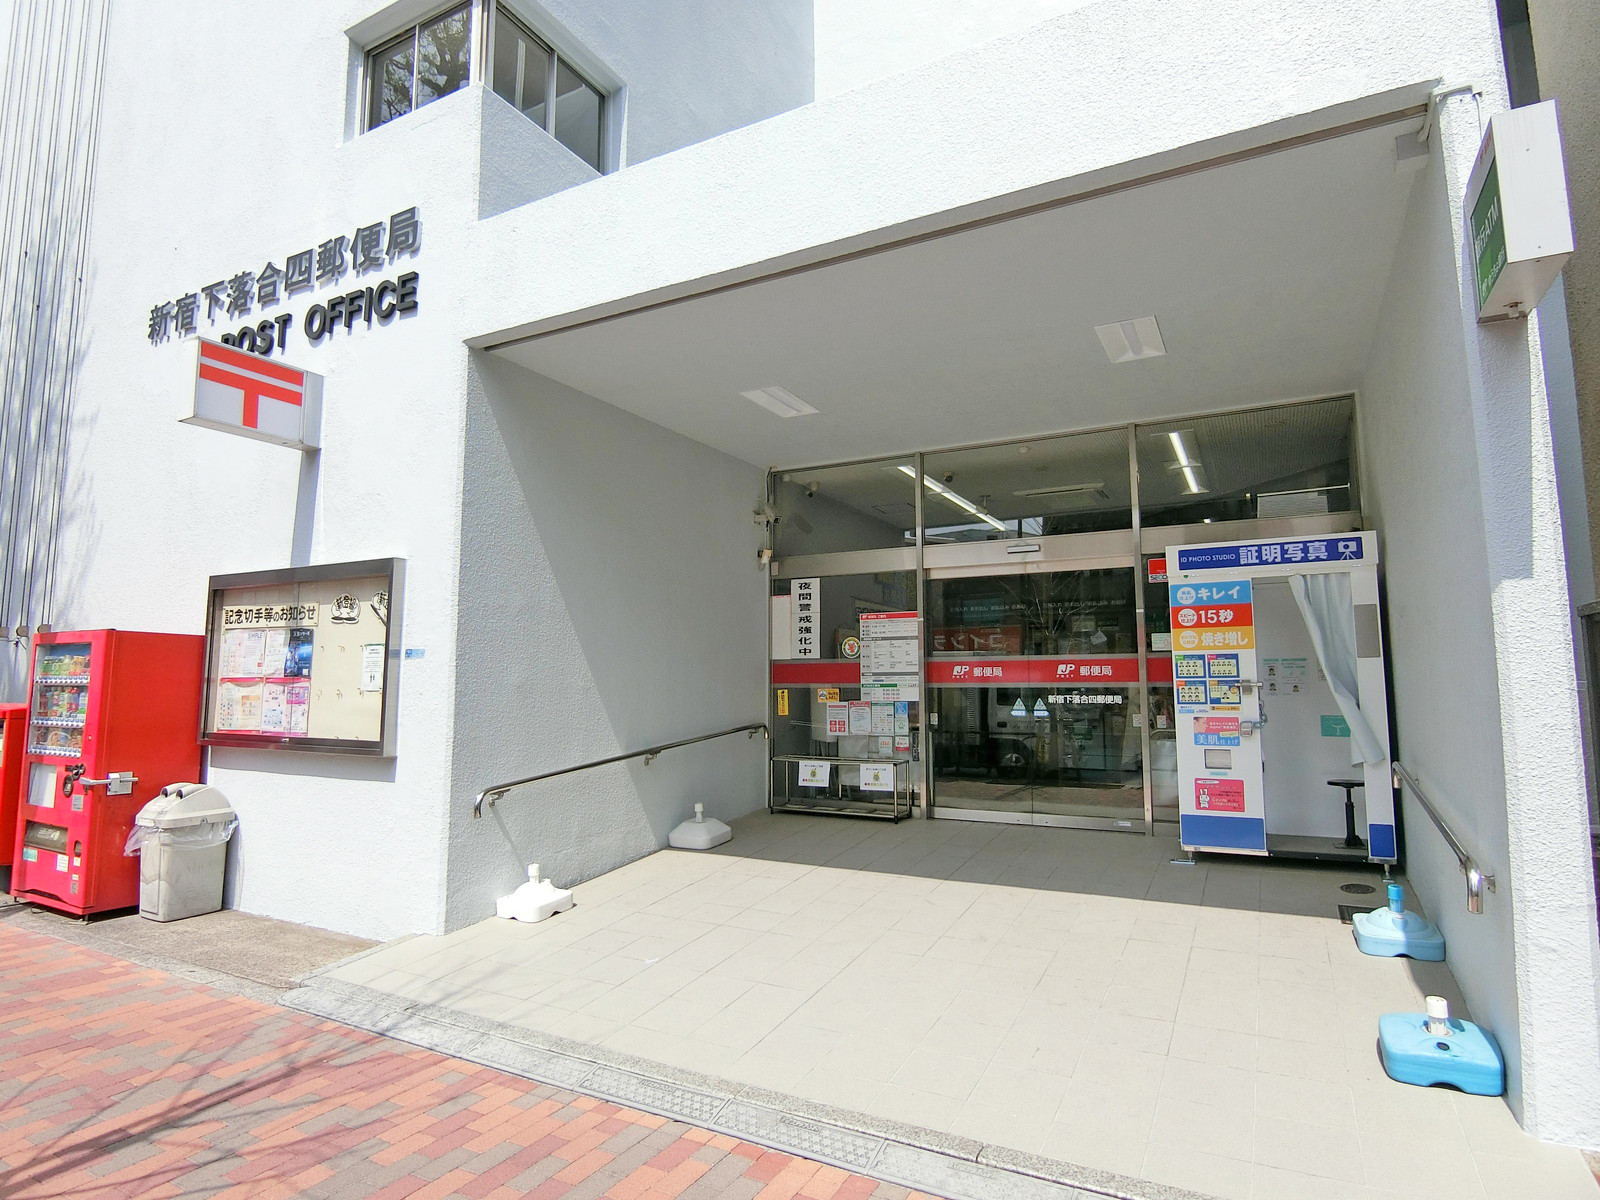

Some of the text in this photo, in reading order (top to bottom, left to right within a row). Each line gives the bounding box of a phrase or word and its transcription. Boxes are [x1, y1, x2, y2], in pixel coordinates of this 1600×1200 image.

[148, 206, 421, 344] 新宿下落合四郵便局
[304, 271, 418, 340] OFFICE
[1212, 553, 1236, 561] STUDIO
[1239, 541, 1328, 565] 証明写真
[1197, 585, 1241, 600] キレイ
[225, 605, 317, 625] 記念切手等のお知らせ
[798, 581, 813, 657] 夜間警戒強化中
[1199, 609, 1234, 624] 15秒
[1201, 631, 1248, 646] 焼き増し
[973, 666, 1003, 677] 郵便局
[1079, 665, 1112, 677] 郵便局
[1048, 694, 1123, 705] 新宿下落合四郵便局
